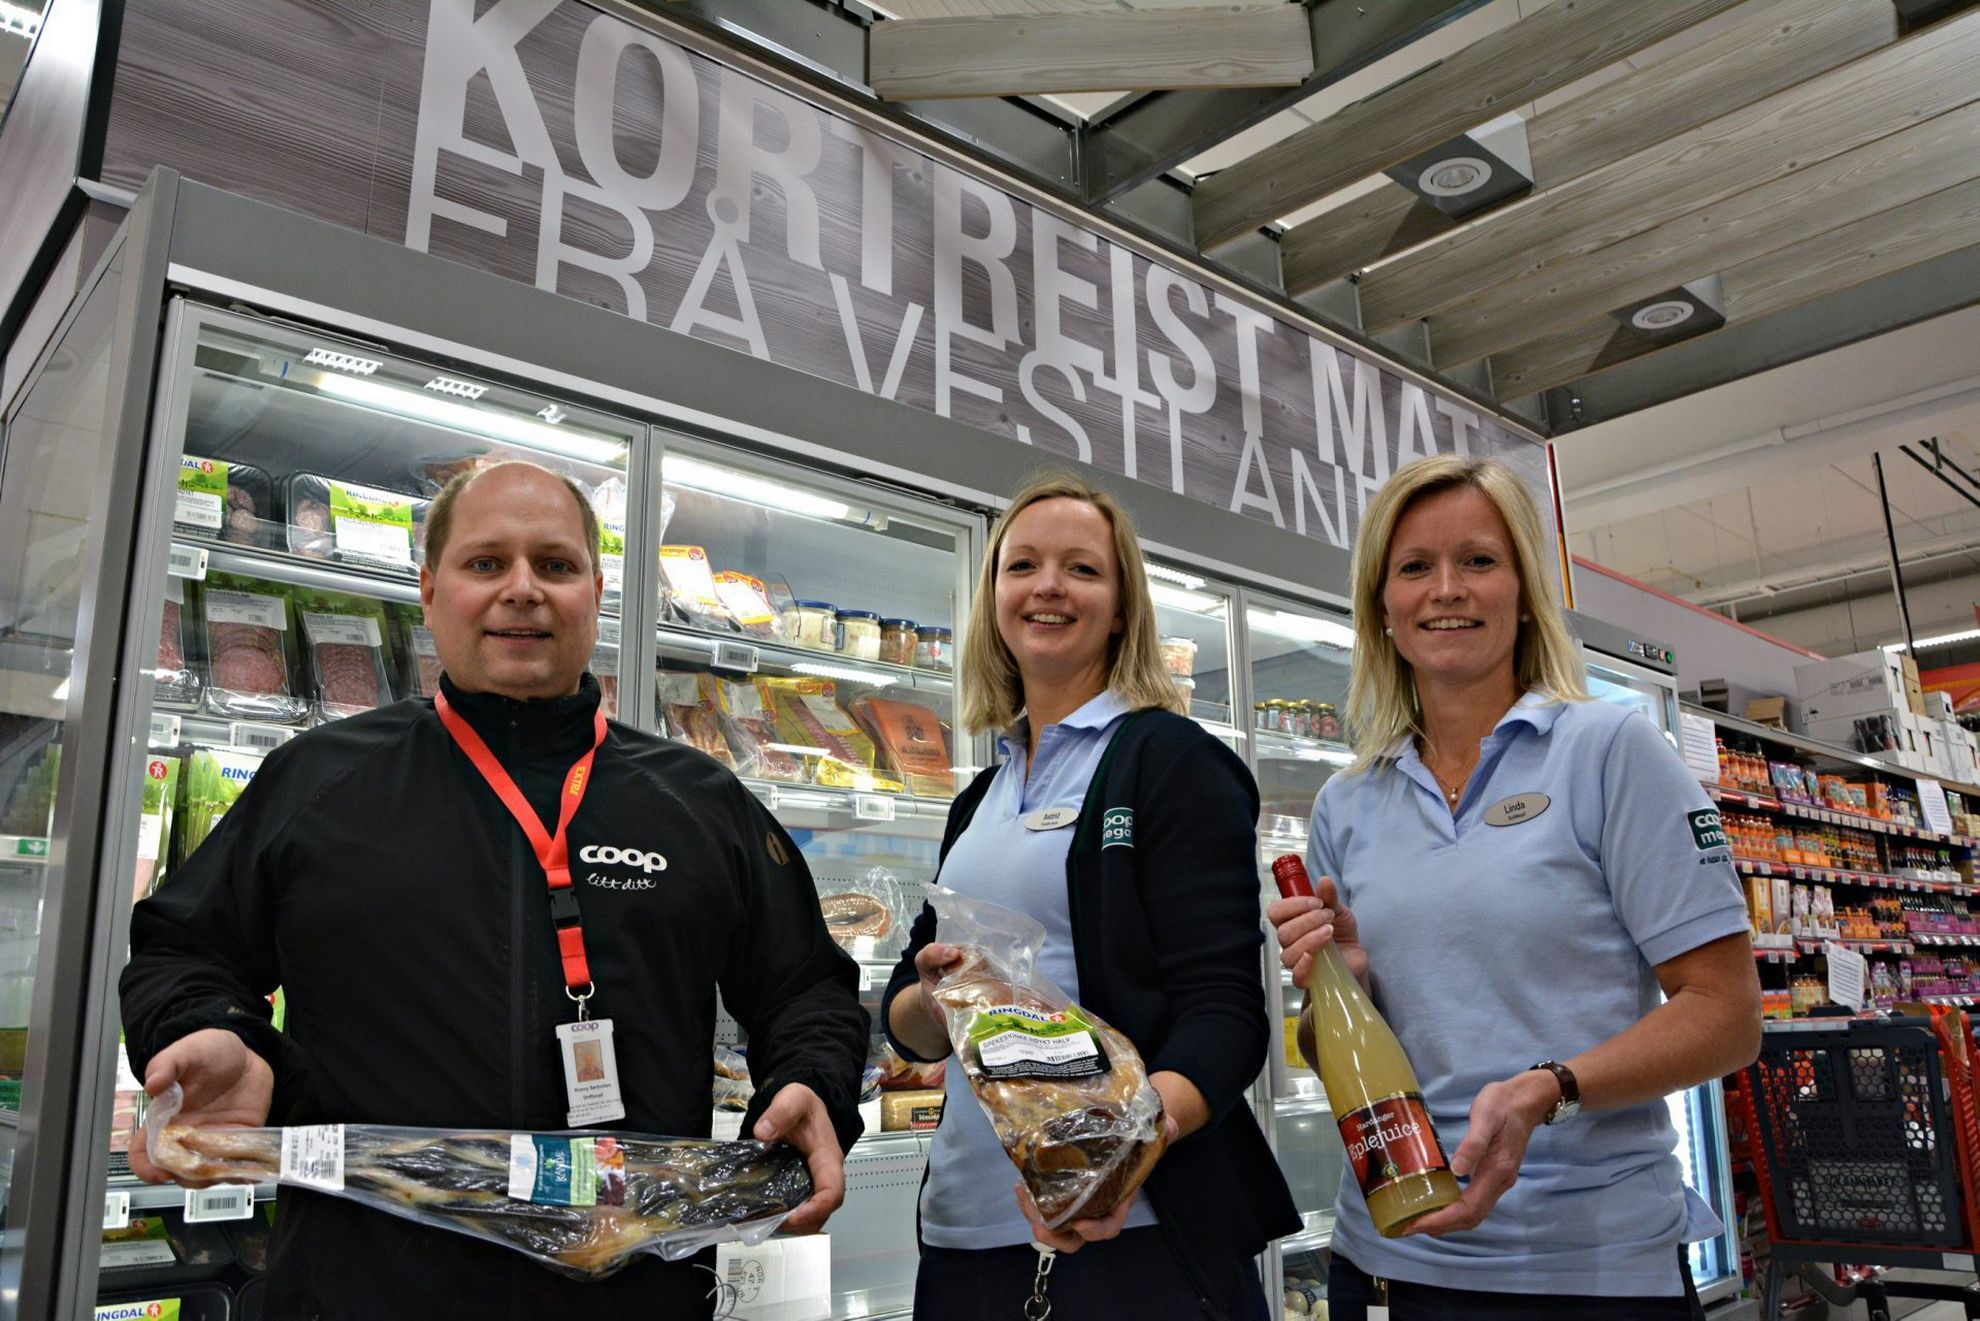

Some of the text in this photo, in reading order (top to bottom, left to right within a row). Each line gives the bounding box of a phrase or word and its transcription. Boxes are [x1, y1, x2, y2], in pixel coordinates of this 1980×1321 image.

[416, 0, 1480, 487] KORTREIST MAT
[568, 765, 587, 796] EXTRA
[1503, 801, 1526, 815] Linda
[579, 845, 668, 874] coop
[988, 1007, 1048, 1022] RINGDAL
[571, 1022, 599, 1032] coop
